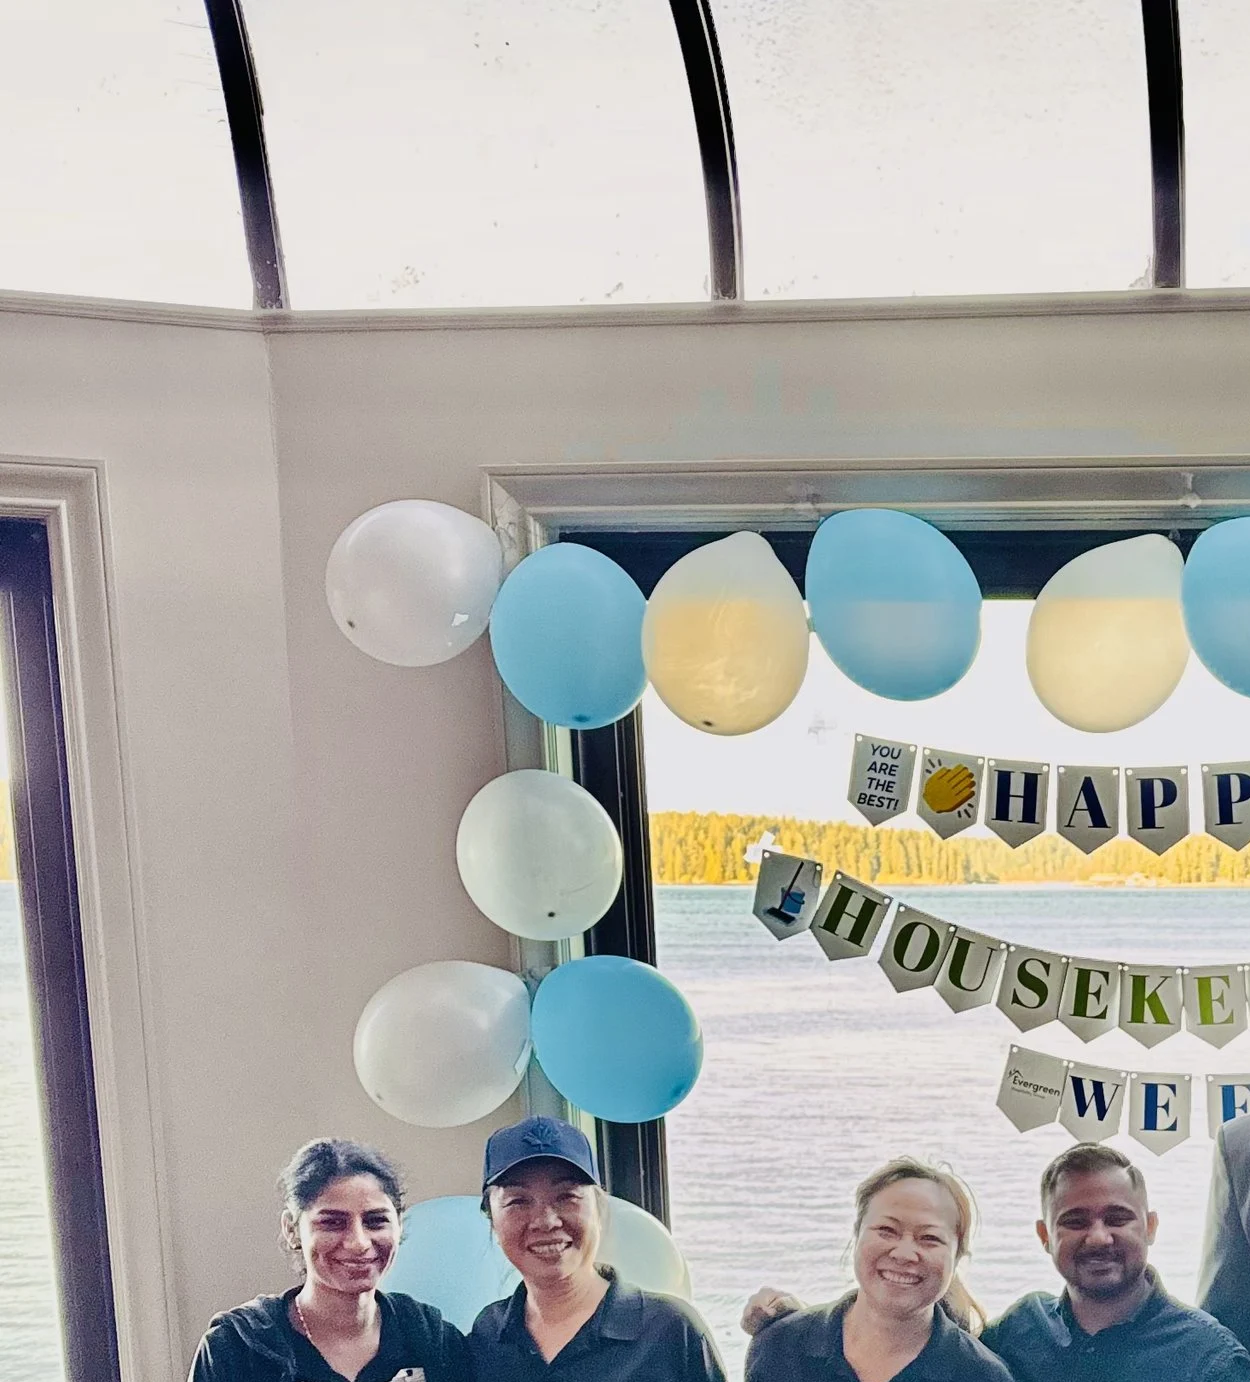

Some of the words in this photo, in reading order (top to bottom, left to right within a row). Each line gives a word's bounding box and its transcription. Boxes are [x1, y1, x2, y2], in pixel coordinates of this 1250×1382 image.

[871, 743, 902, 760] YOU
[867, 761, 899, 777] ARE
[867, 777, 896, 793] THE
[857, 793, 900, 811] BEST!
[1012, 1075, 1060, 1097] Evergreen
